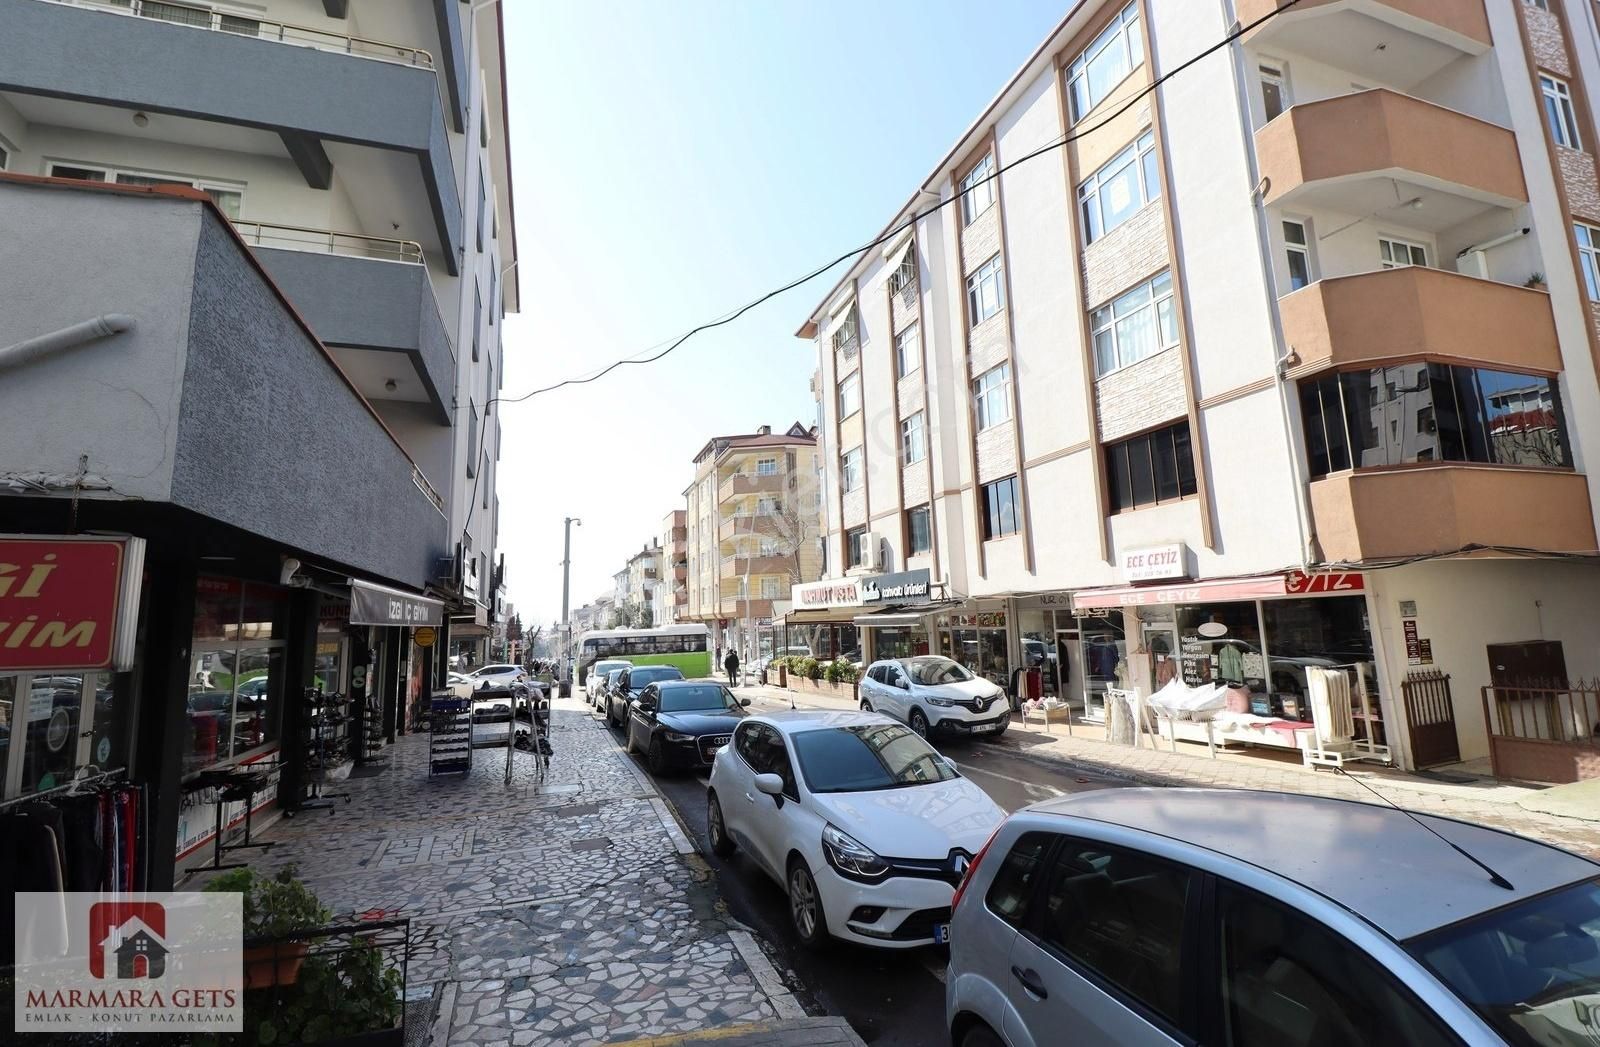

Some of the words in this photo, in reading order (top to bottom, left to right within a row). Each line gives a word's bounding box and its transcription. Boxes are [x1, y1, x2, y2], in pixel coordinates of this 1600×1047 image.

[1127, 555, 1144, 568] ECE
[1120, 594, 1145, 604] ECE
[1181, 644, 1202, 652] Yorgan
